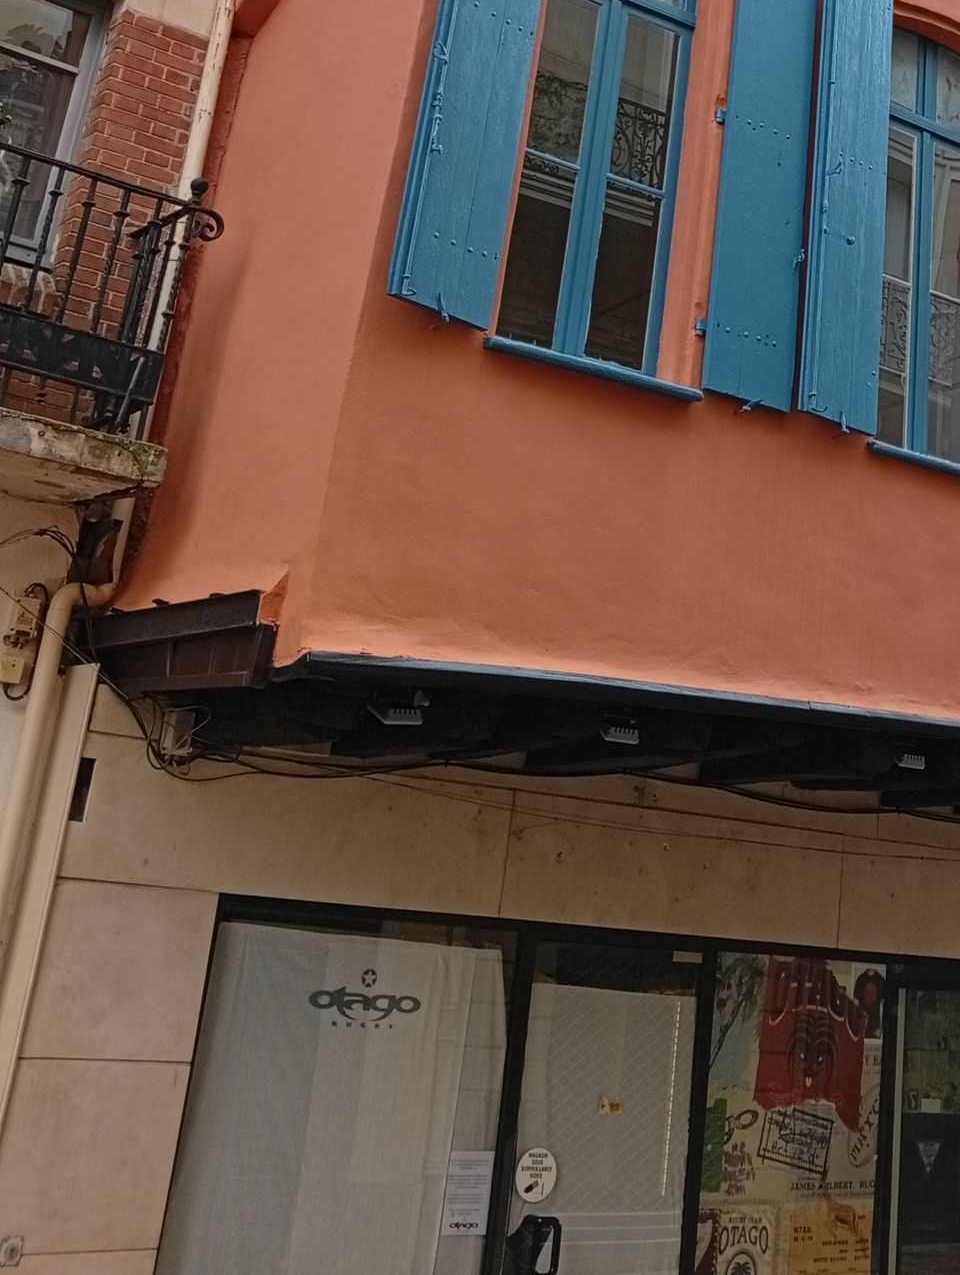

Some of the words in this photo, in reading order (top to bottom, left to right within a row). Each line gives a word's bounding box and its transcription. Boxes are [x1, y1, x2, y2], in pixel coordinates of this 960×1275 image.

[308, 986, 422, 1022] otago
[789, 1181, 816, 1191] JAMES
[718, 1225, 769, 1256] OTAGO
